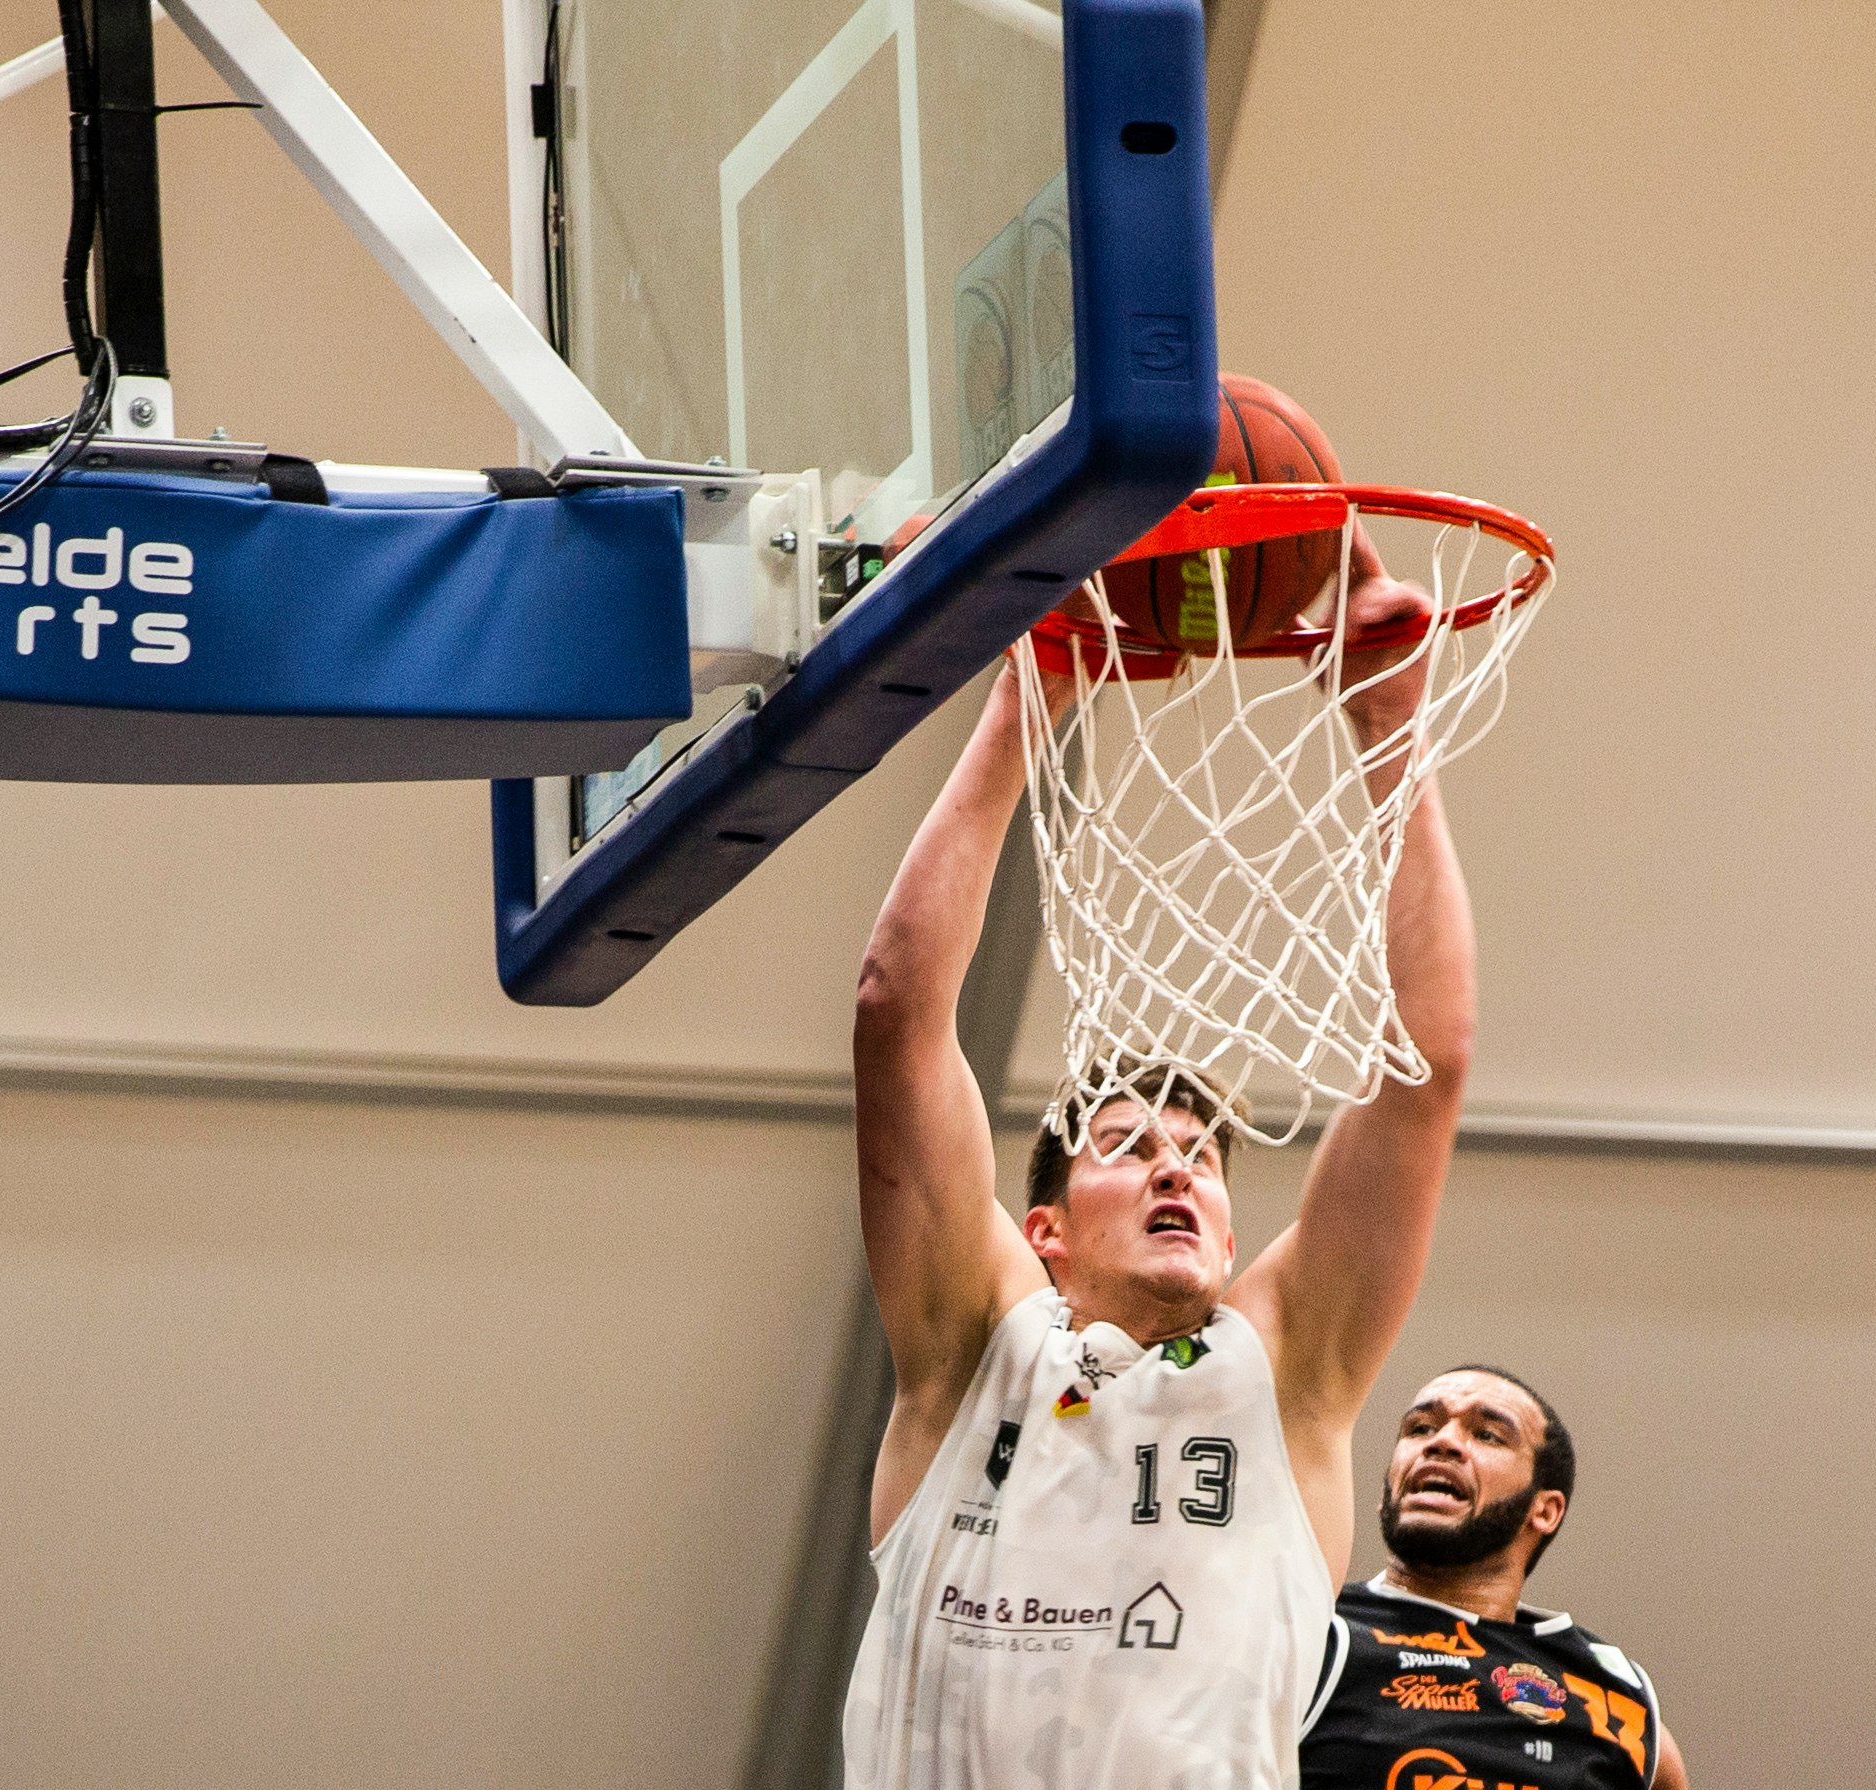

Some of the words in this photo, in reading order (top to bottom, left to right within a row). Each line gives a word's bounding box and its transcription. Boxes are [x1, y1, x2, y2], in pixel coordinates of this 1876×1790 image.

[1131, 1436, 1238, 1528] 13
[995, 1598, 1013, 1623] &
[1023, 1598, 1113, 1624] Bauen
[1398, 1651, 1471, 1670] SPALDING
